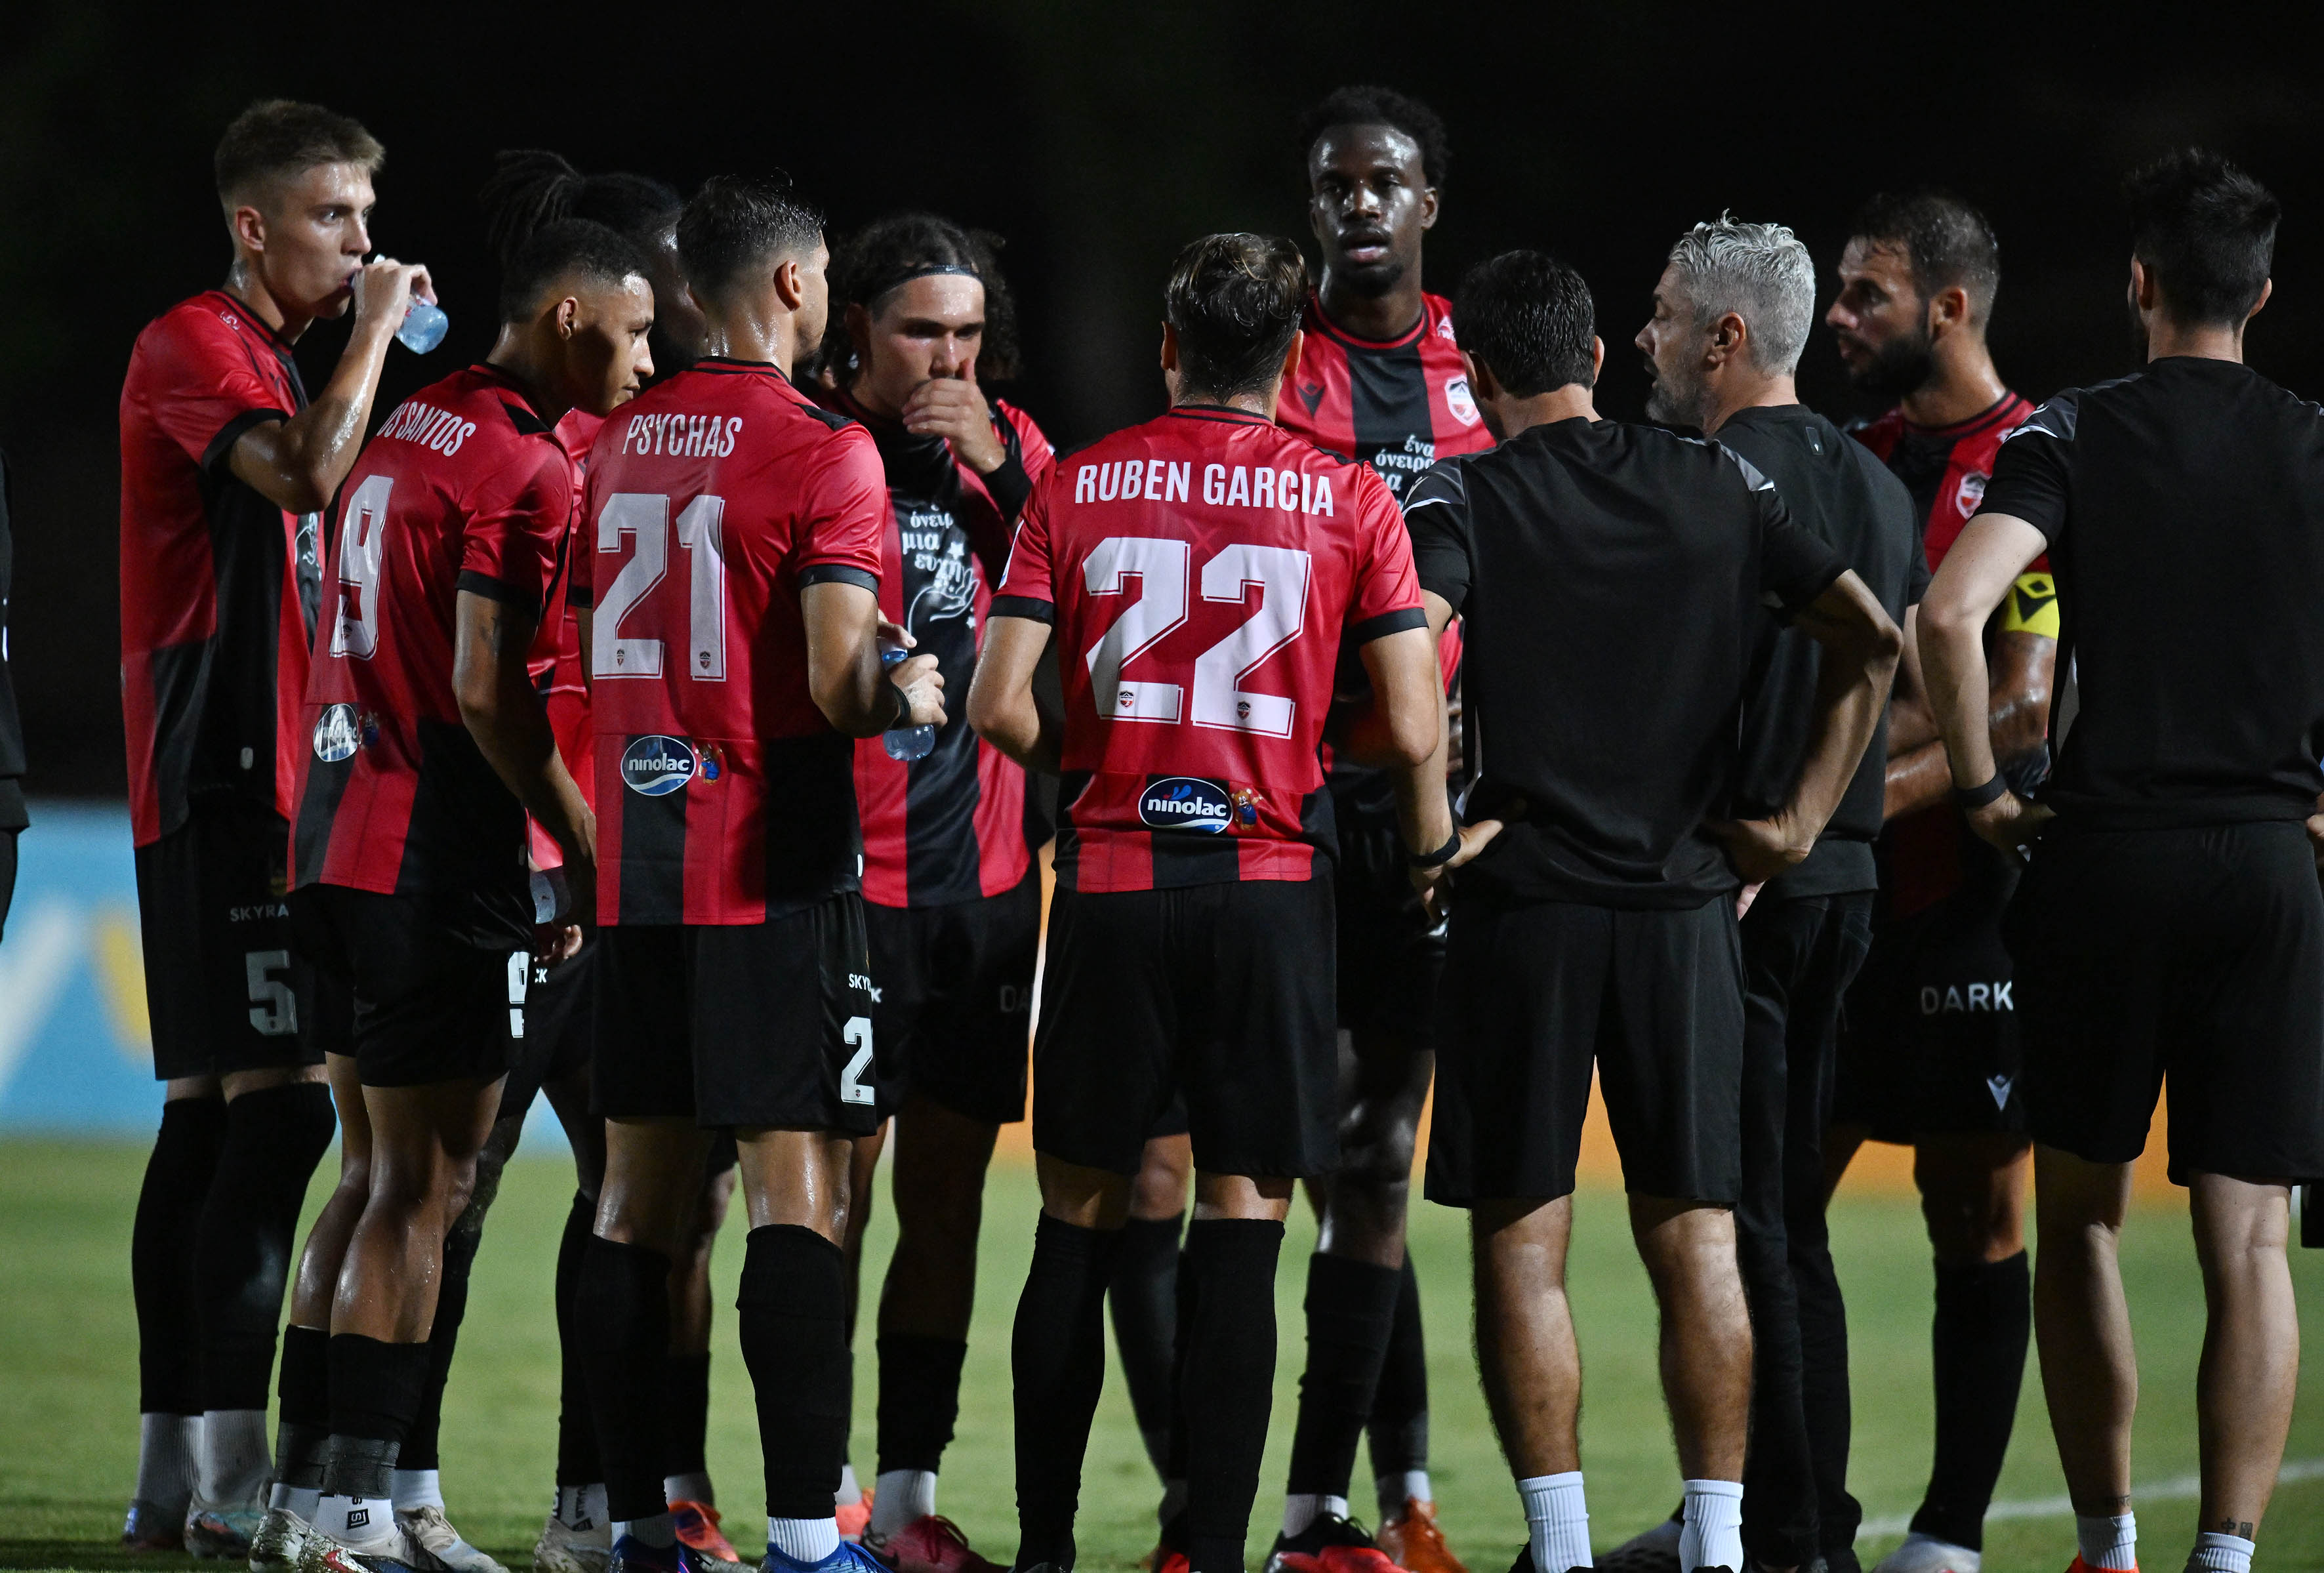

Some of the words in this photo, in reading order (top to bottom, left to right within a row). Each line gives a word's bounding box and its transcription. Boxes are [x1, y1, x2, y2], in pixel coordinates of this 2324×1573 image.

[395, 401, 477, 457] SANTOS
[621, 413, 743, 458] PSYCHAS
[1404, 434, 1435, 457] ένα
[1075, 459, 1191, 503] RUBEN
[1203, 463, 1334, 517] GARCIA
[330, 475, 394, 661] 9
[592, 493, 726, 682] 21
[1082, 537, 1311, 739] 22
[628, 752, 690, 771] ninolac
[1147, 796, 1227, 817] ninolac
[245, 949, 298, 1035] 5
[1921, 980, 2014, 1015] DARK
[841, 1016, 875, 1106] 2
